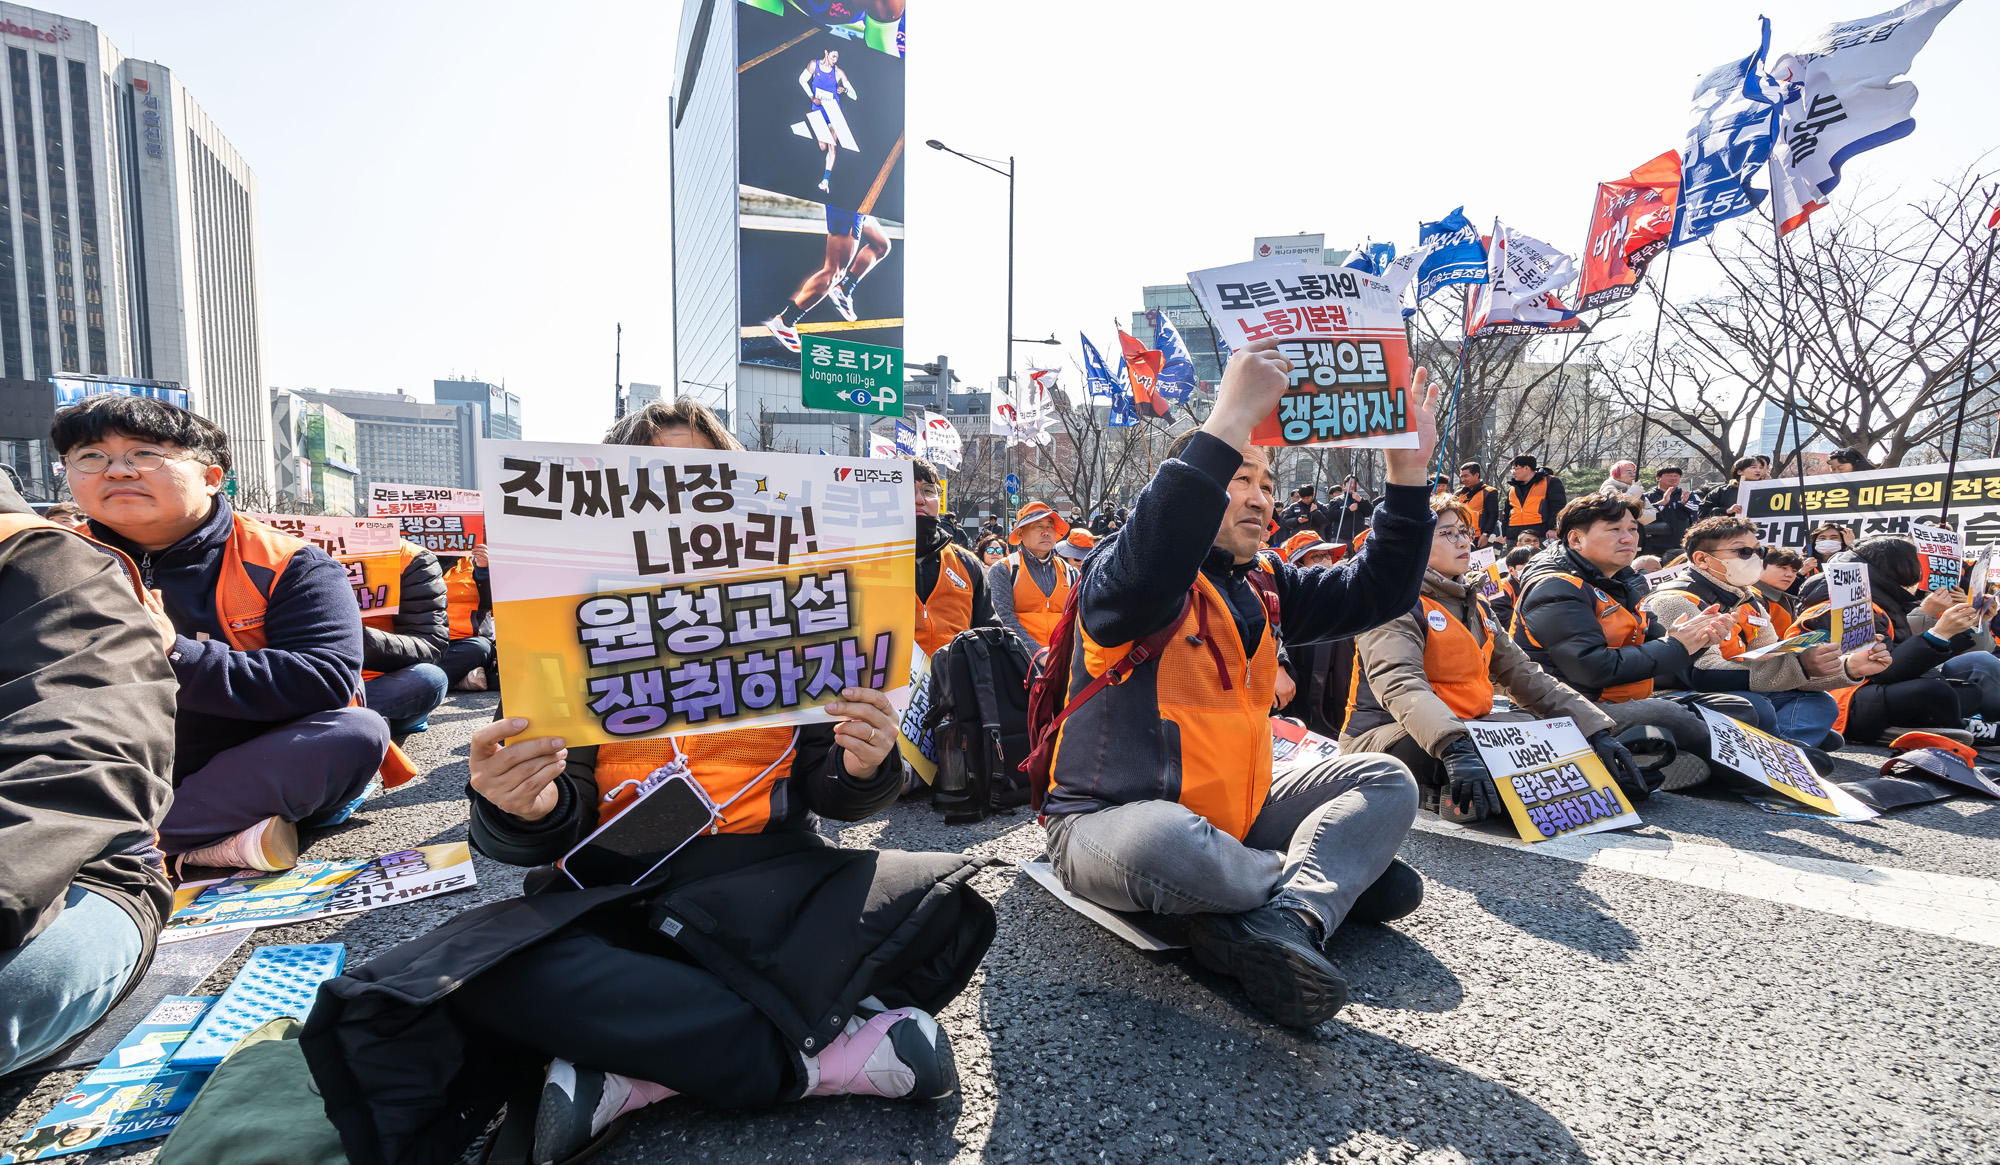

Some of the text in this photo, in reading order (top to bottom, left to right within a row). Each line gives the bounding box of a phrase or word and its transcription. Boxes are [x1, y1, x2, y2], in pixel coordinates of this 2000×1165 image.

[1216, 273, 1361, 311] 모든 노동자의
[1237, 305, 1349, 342] 노동기본권
[809, 368, 876, 387] Jongno 1(il)-ga
[810, 344, 894, 375] 종로1가
[1279, 341, 1390, 387] 투쟁으로
[857, 390, 865, 403] 6
[1279, 389, 1407, 442] 쟁취하자!
[500, 458, 737, 520] 진짜사장
[854, 468, 903, 484] 민주노총
[373, 489, 452, 501] 모든 노동자의
[376, 502, 438, 515] 노동기본권
[1770, 492, 1792, 511] 이
[1799, 488, 1850, 511] 땅은
[1857, 480, 1943, 506] 미국의
[632, 506, 819, 576] 나와라!
[577, 569, 853, 668] 원청교섭
[587, 632, 893, 736] 쟁취하자!
[1473, 727, 1525, 748] 진짜사장
[1509, 740, 1559, 769] 나와라!
[1511, 763, 1589, 806] 원청교섭
[1527, 787, 1622, 837] 쟁취하자!
